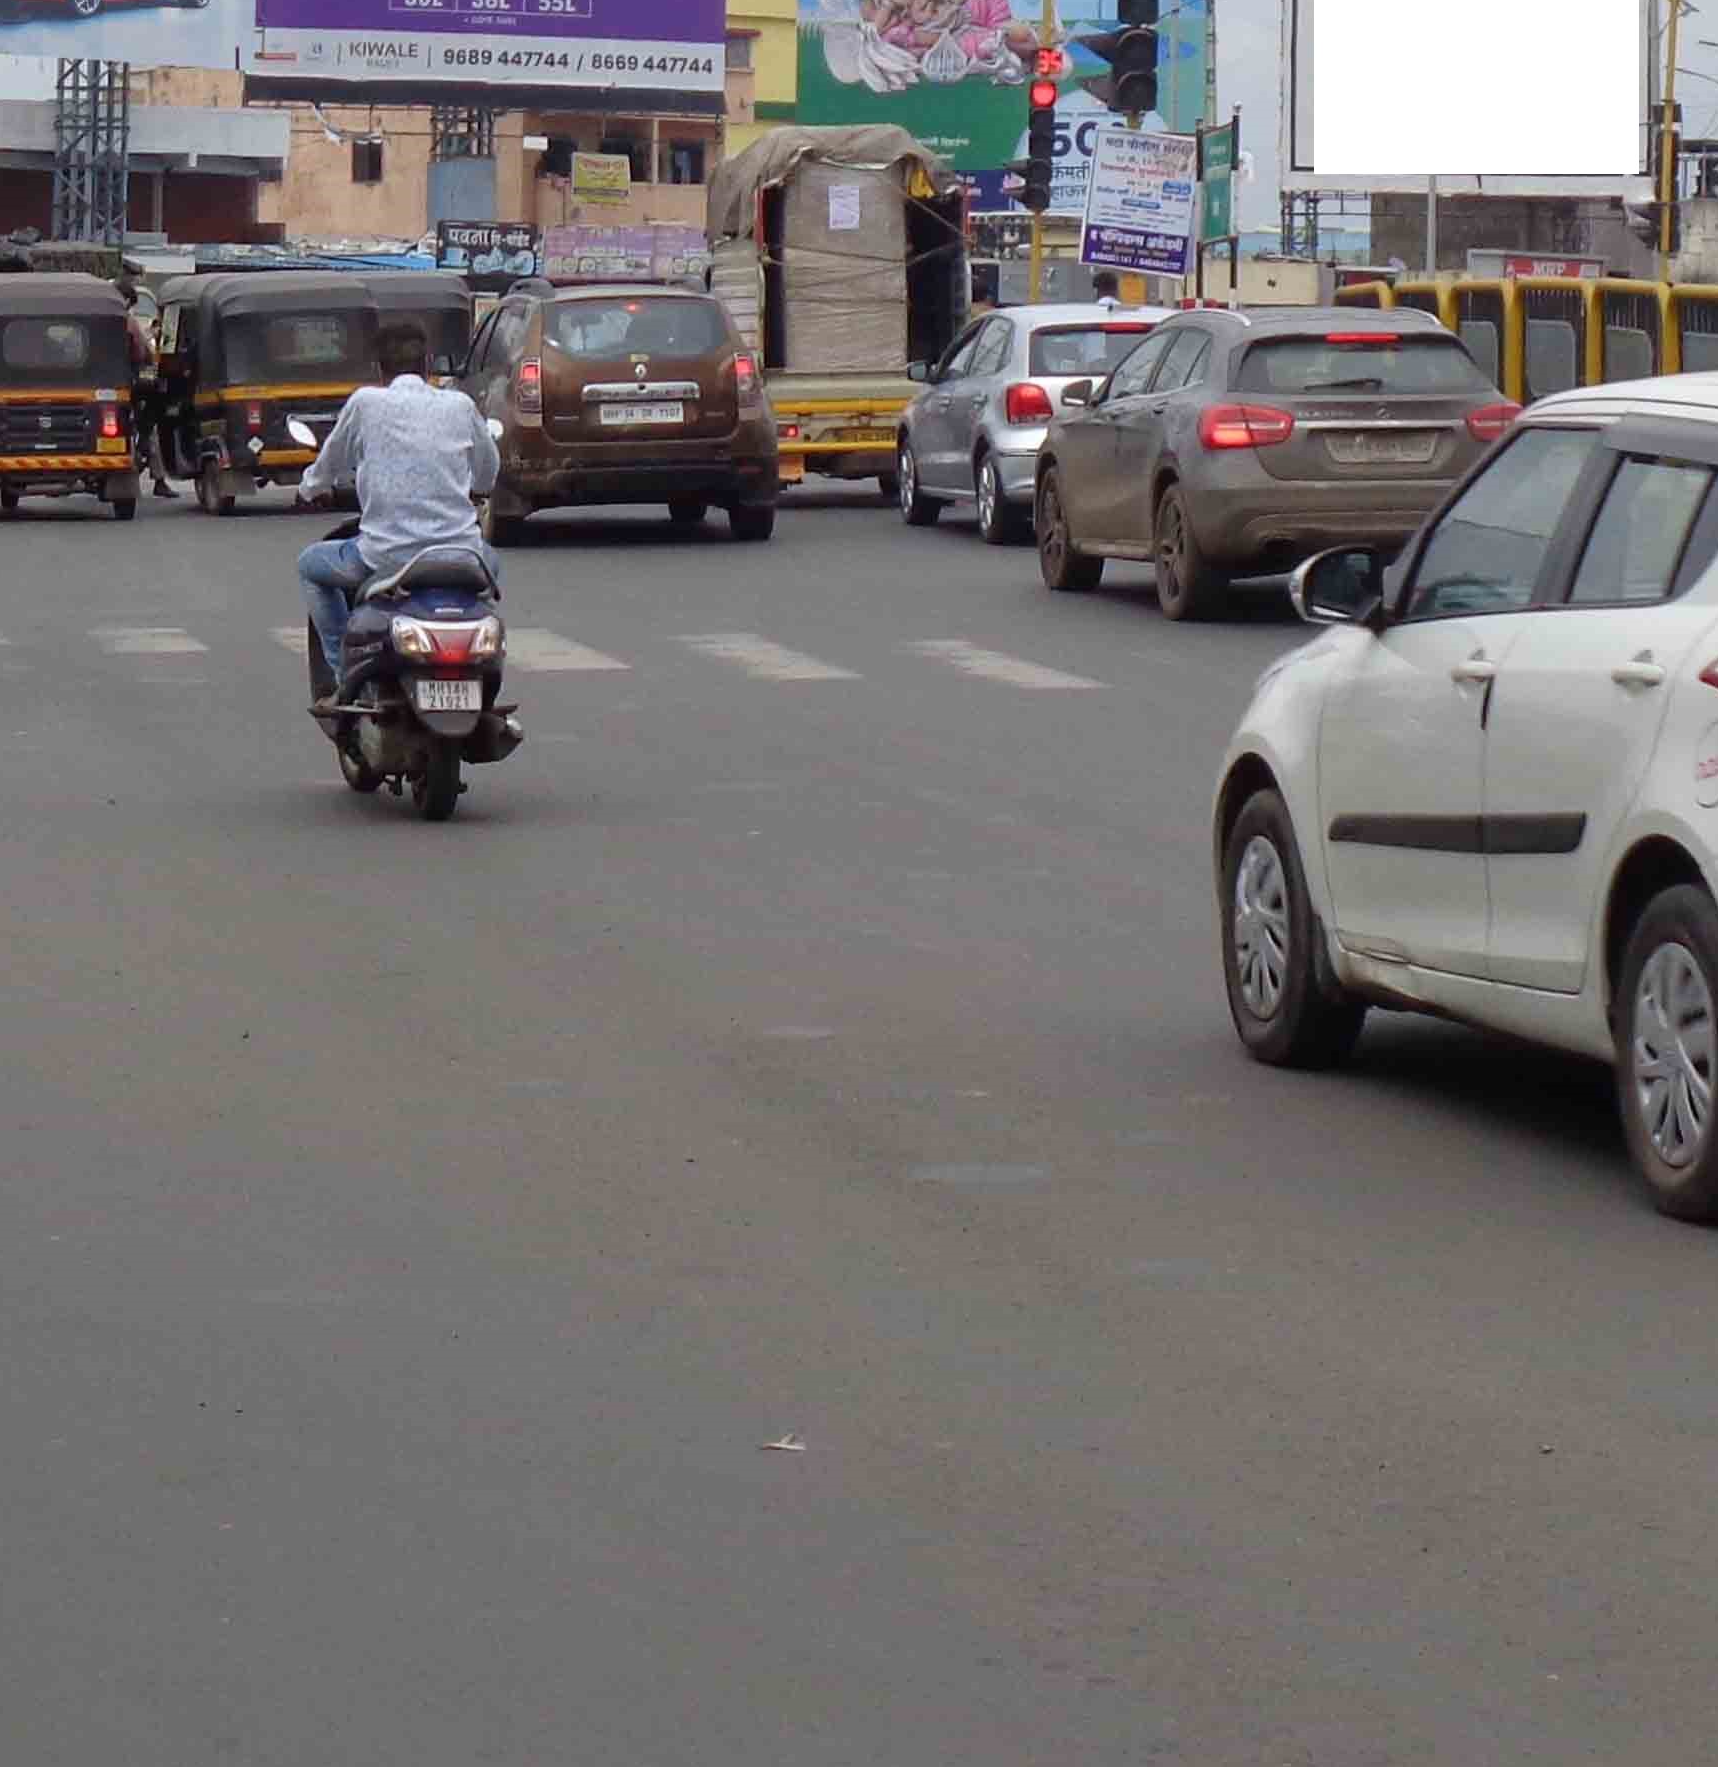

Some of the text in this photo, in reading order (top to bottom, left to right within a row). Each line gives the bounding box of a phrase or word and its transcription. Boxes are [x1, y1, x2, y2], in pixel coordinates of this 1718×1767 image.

[349, 42, 419, 58] KIWALE
[443, 48, 493, 66] 9689
[498, 50, 570, 69] 447744
[591, 54, 639, 72] 8669
[643, 55, 714, 75] 447744
[1038, 49, 1063, 75] 35
